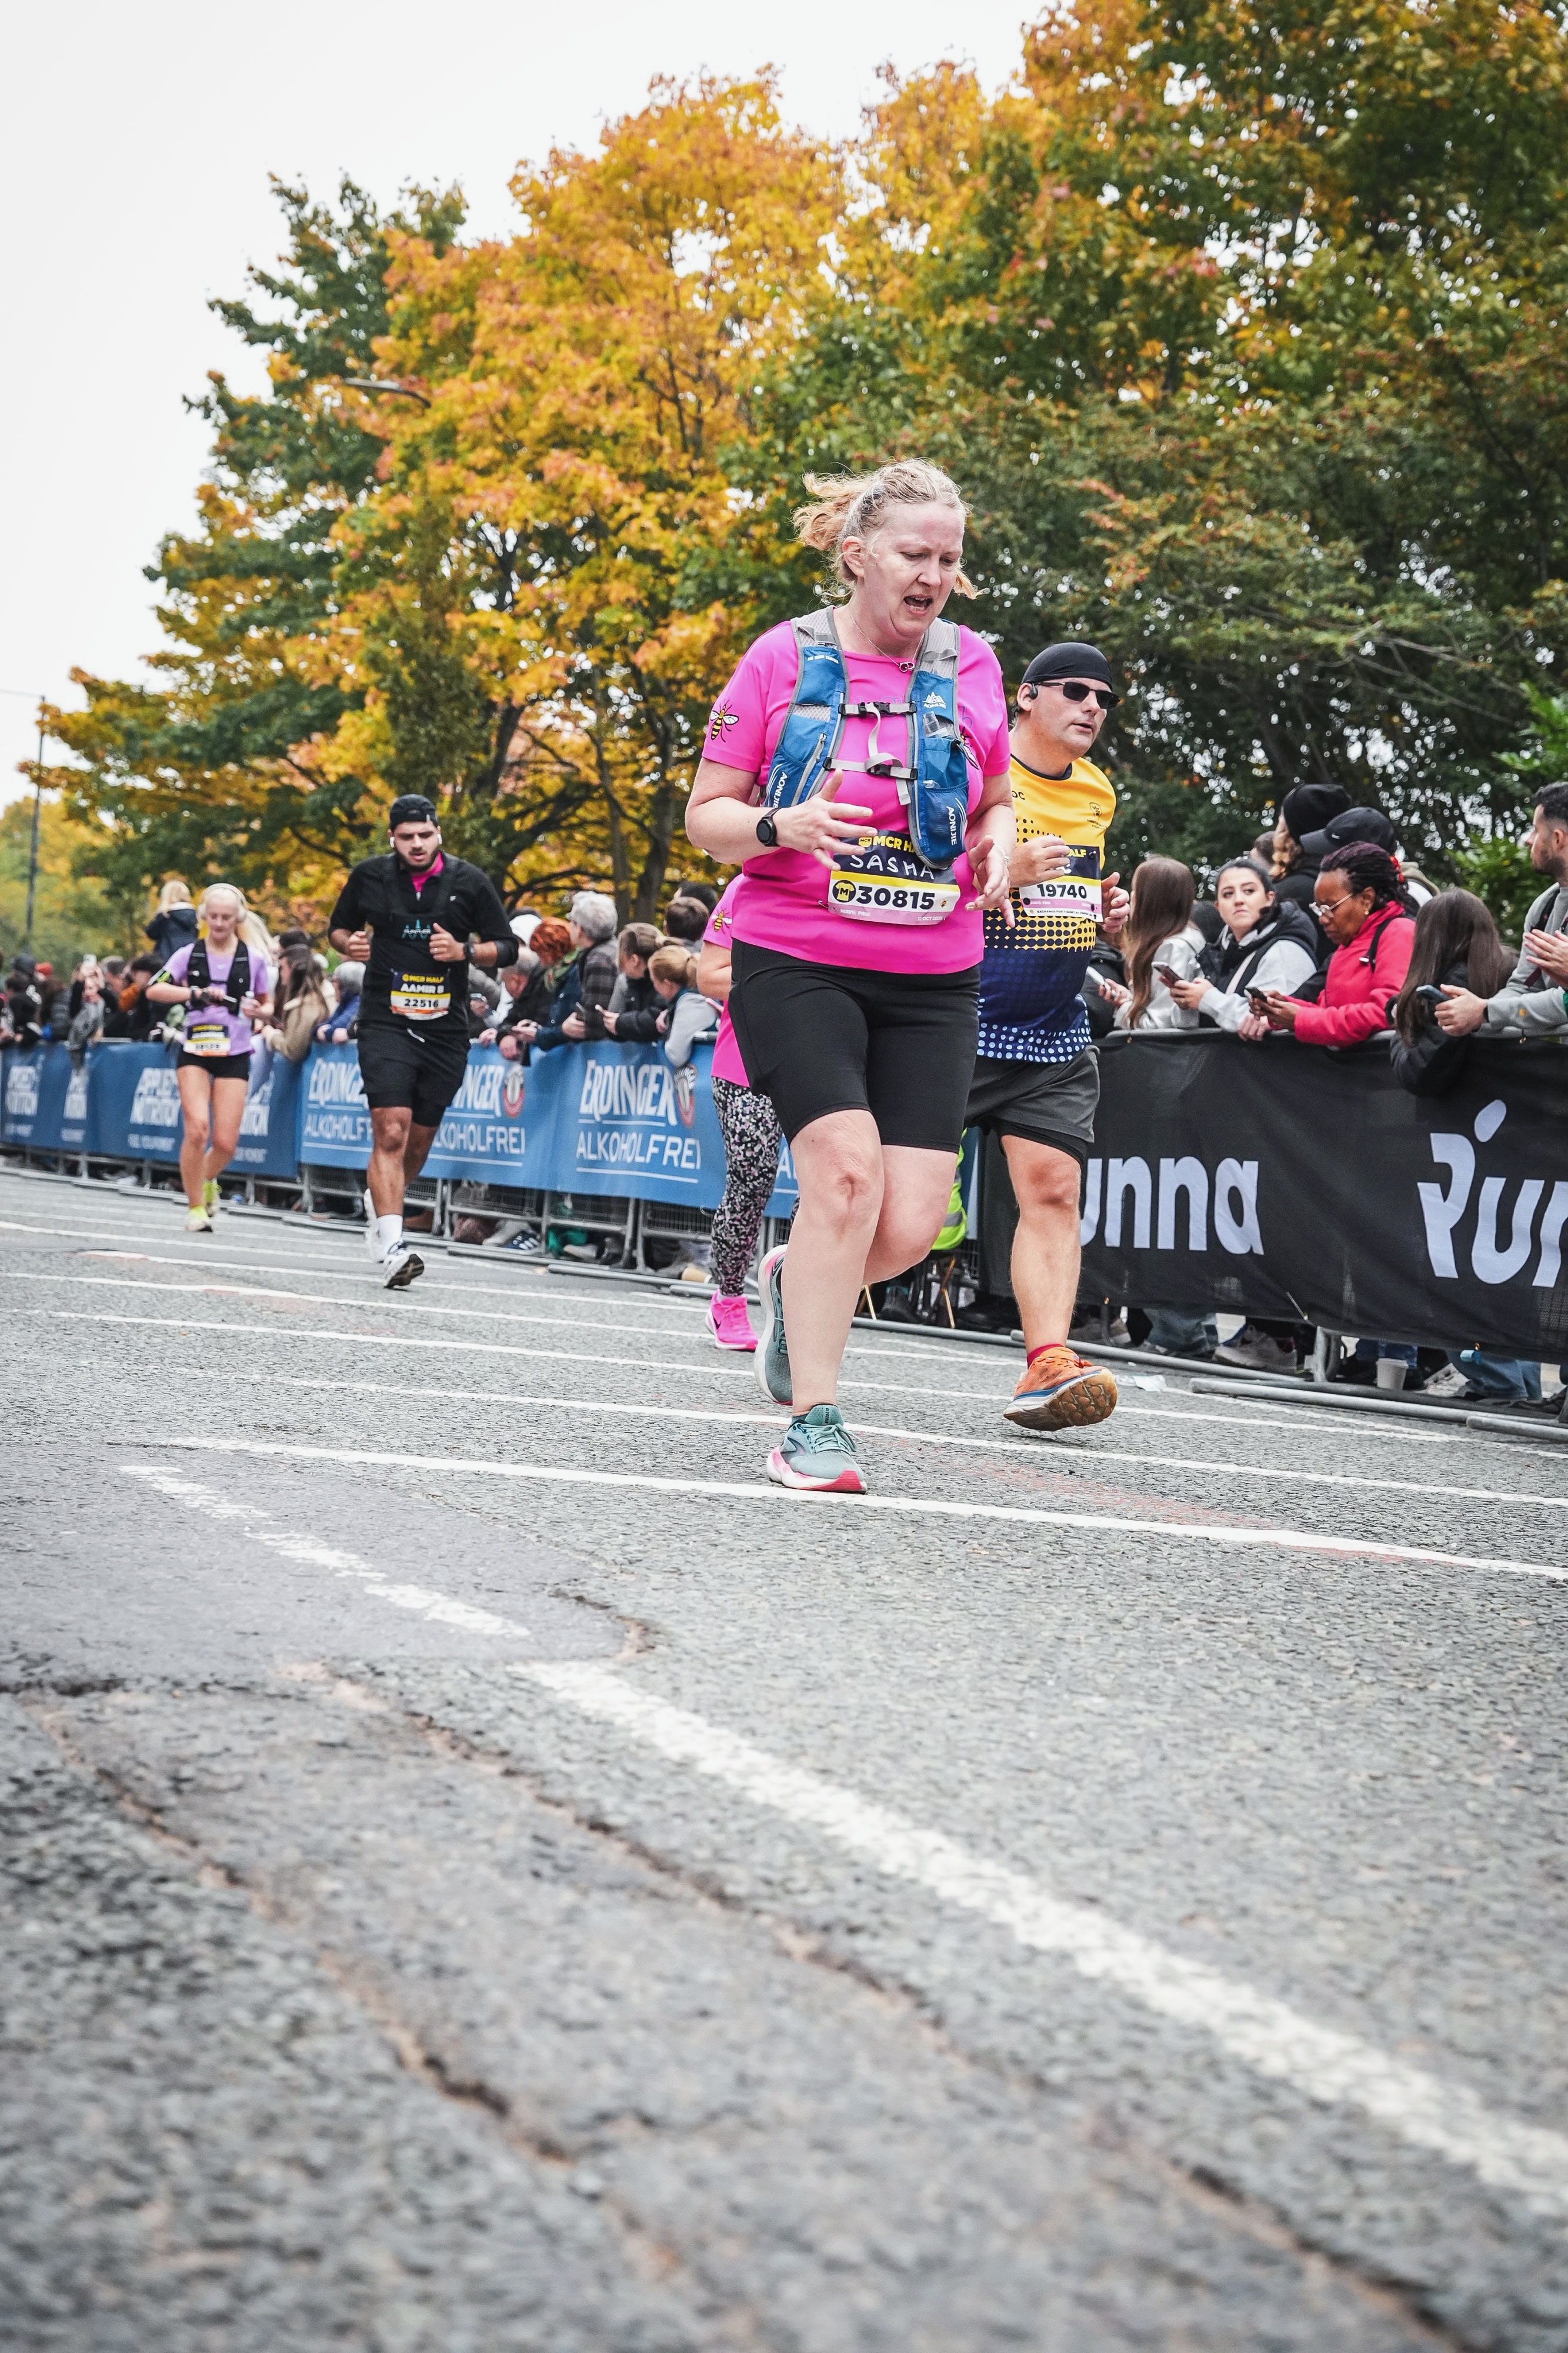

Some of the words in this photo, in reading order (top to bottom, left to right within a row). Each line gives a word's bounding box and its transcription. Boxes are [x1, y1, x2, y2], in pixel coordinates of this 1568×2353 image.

[946, 805, 957, 846] AONIJIE
[873, 835, 902, 850] MCR
[903, 840, 915, 853] H
[1061, 849, 1086, 858] ALF
[850, 855, 935, 879] SASHA
[856, 885, 935, 910] 30815
[1037, 884, 1087, 899] 19740
[401, 983, 436, 994] AAMIR
[405, 999, 438, 1008] 22516
[579, 1059, 678, 1126] ERDINGER
[576, 1131, 701, 1170] ALKOHOLFREI
